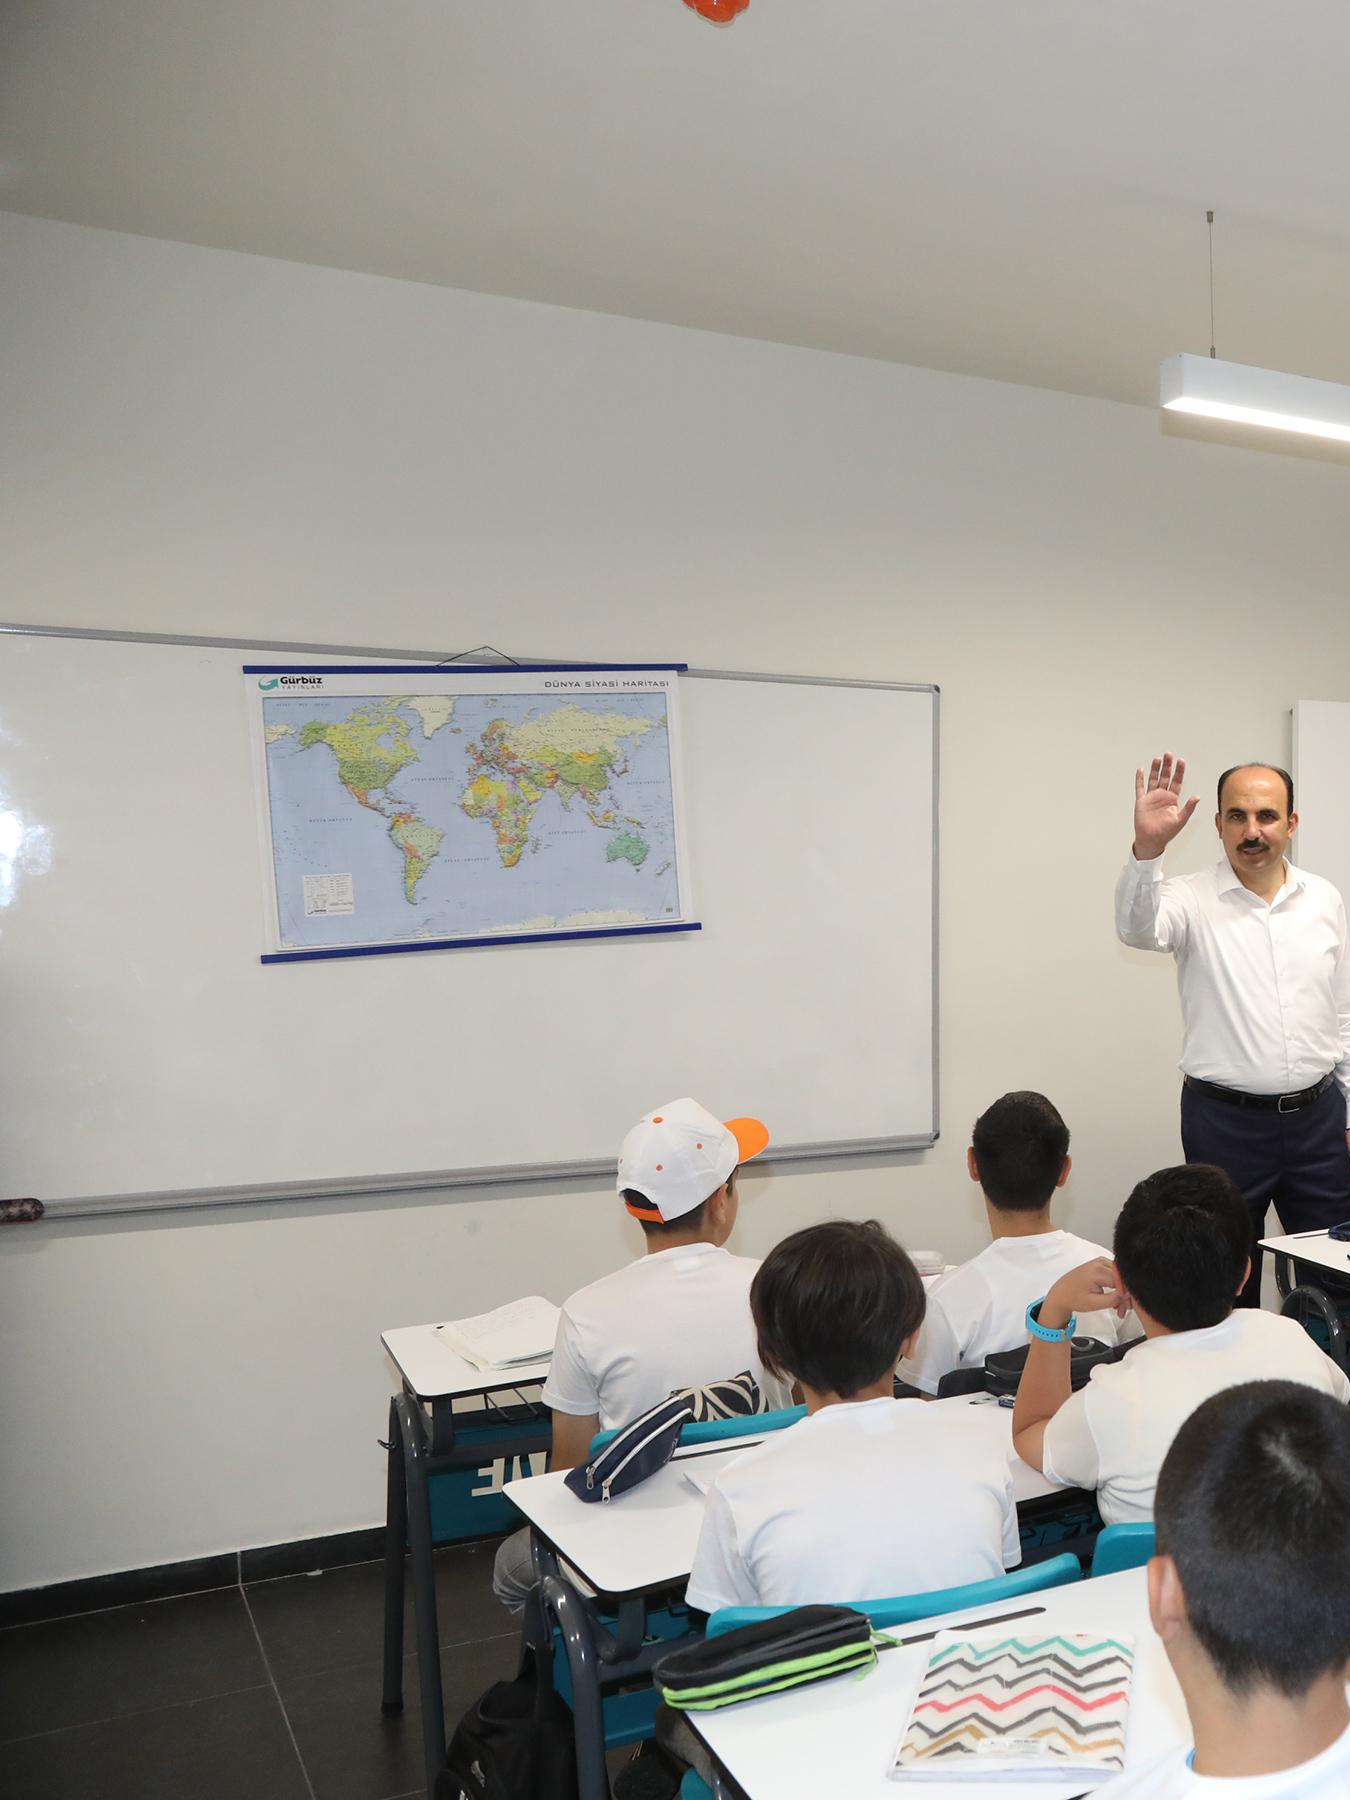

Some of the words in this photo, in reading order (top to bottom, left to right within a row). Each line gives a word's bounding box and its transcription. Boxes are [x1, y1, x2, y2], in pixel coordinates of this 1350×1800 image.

[280, 676, 322, 685] Gürbüz
[544, 680, 581, 688] DÜNYA
[585, 679, 619, 688] SİYASİ
